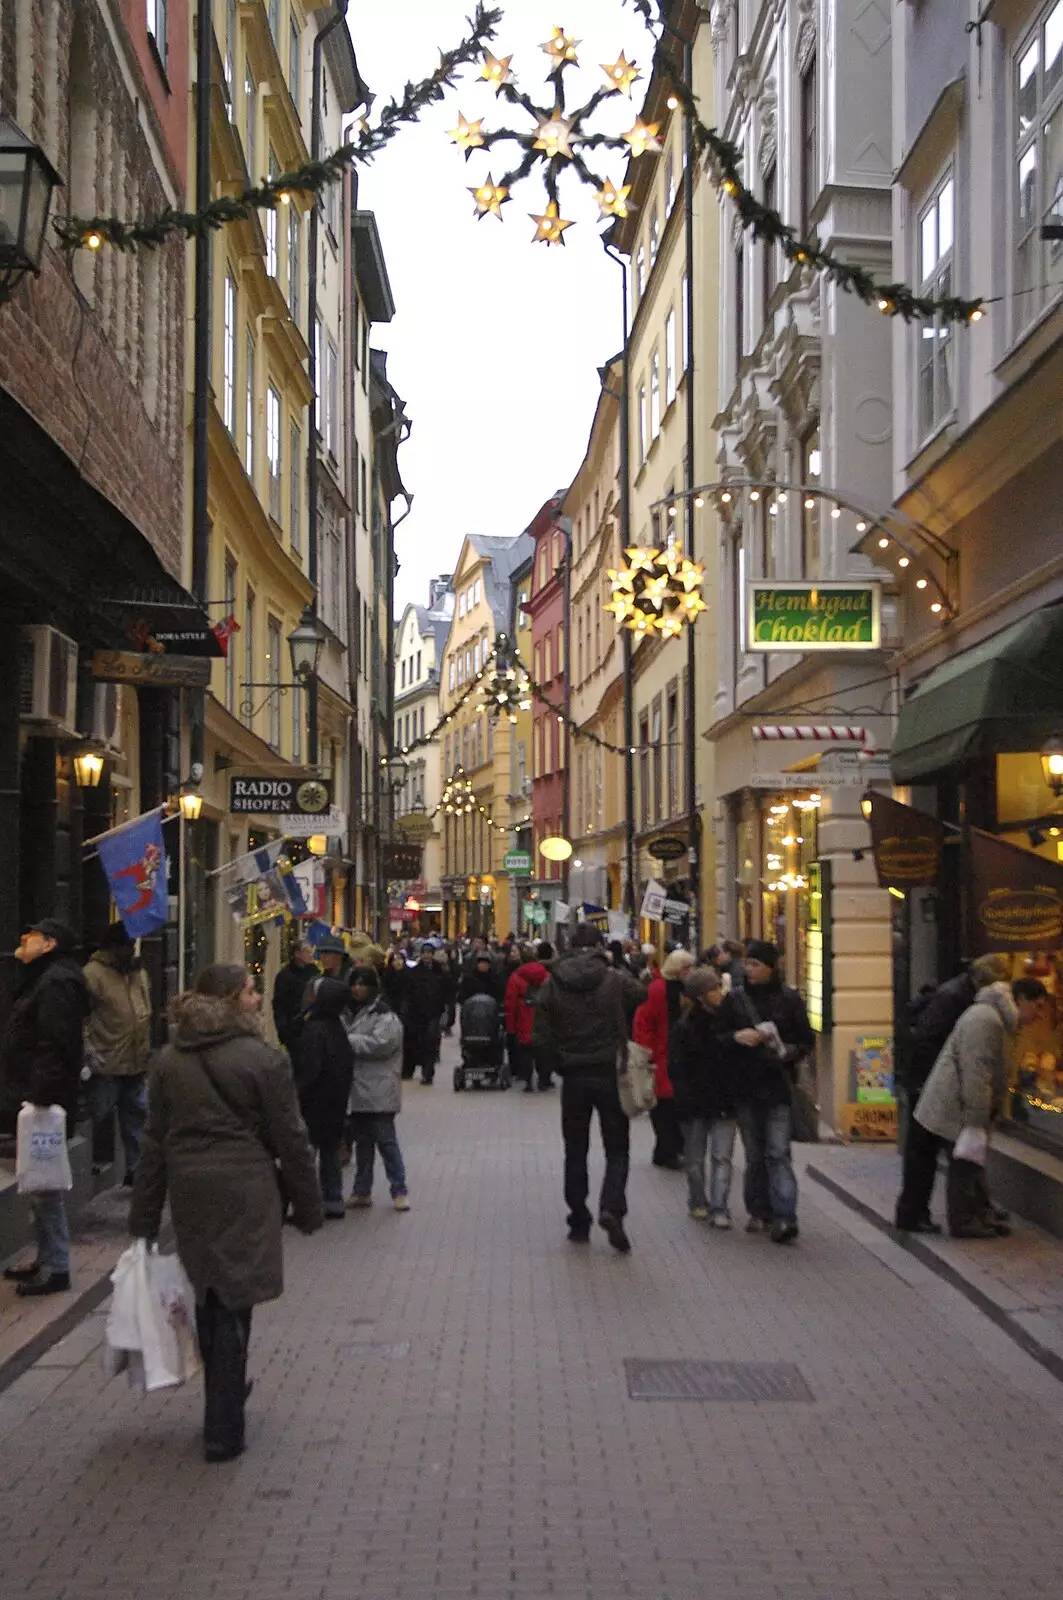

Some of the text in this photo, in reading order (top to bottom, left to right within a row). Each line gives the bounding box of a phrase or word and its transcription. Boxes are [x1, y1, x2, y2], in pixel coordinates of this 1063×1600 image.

[755, 615, 868, 642] Choklad
[235, 781, 293, 797] RADIO
[233, 799, 292, 811] SHOPEN
